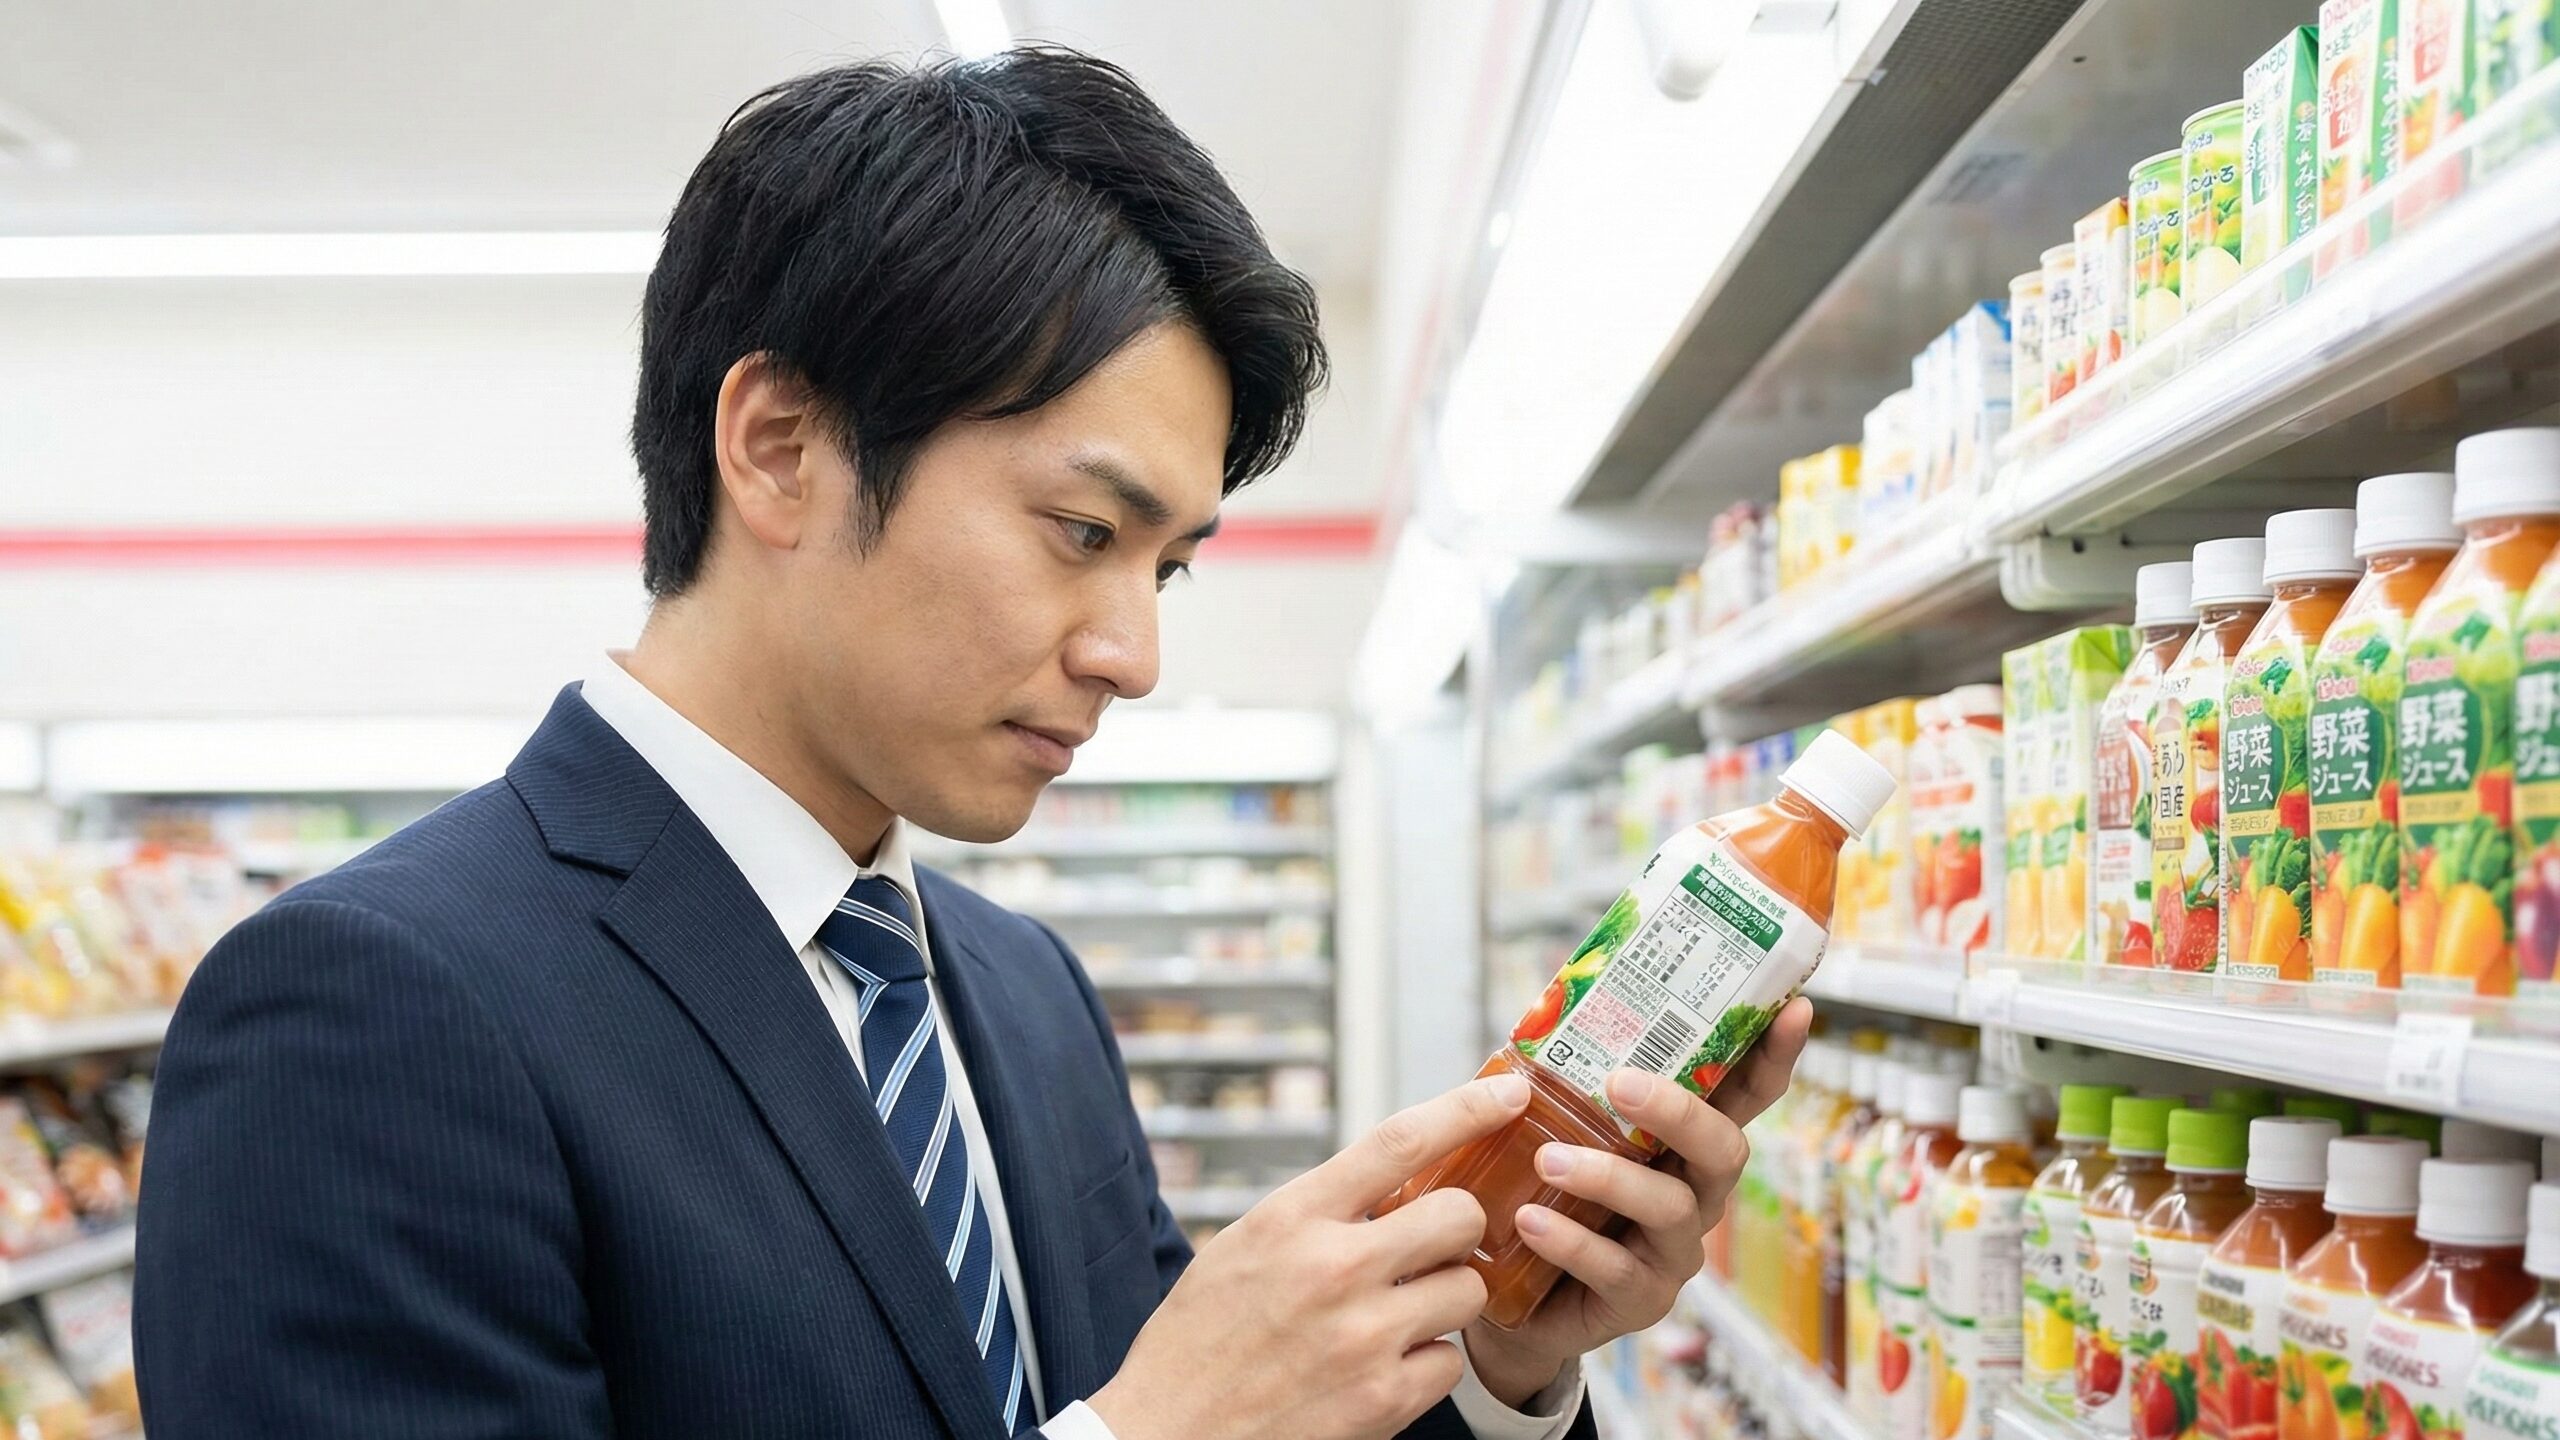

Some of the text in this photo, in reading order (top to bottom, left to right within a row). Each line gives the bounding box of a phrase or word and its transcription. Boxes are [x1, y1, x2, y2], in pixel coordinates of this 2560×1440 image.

[2312, 707, 2370, 761] 野菜
[2401, 689, 2468, 748] 野菜
[2228, 723, 2272, 772] 野菜
[2402, 748, 2470, 789] ジュース
[2228, 774, 2274, 805] ジュース
[2312, 761, 2372, 797] ジュース
